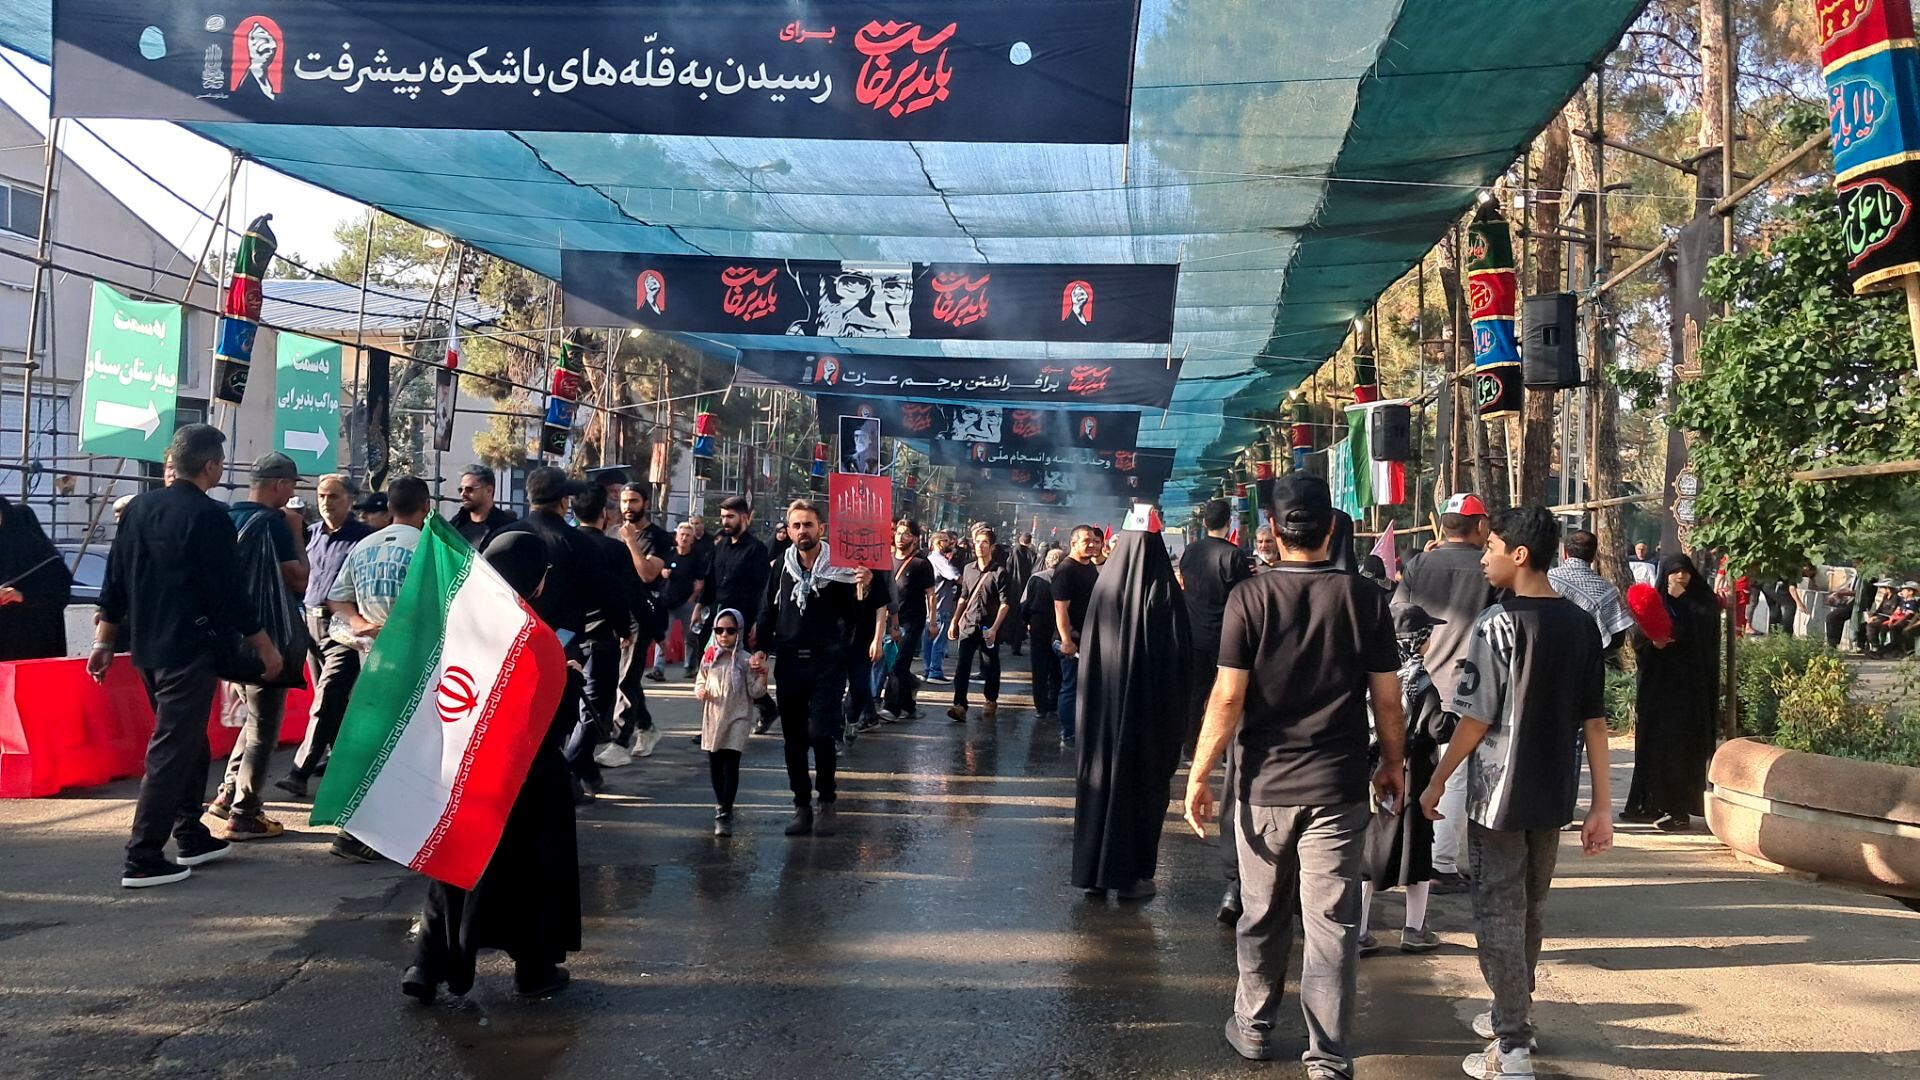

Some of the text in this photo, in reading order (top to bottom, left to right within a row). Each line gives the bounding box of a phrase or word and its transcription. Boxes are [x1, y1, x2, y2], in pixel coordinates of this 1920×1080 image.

[779, 20, 836, 44] برای
[293, 42, 427, 100] پیشرفت
[430, 46, 546, 97] باشکوه
[677, 59, 713, 100] به
[715, 57, 833, 104] رسیدن
[841, 371, 1060, 393] برافراشتن پرچم عزت
[386, 545, 414, 566] YOR
